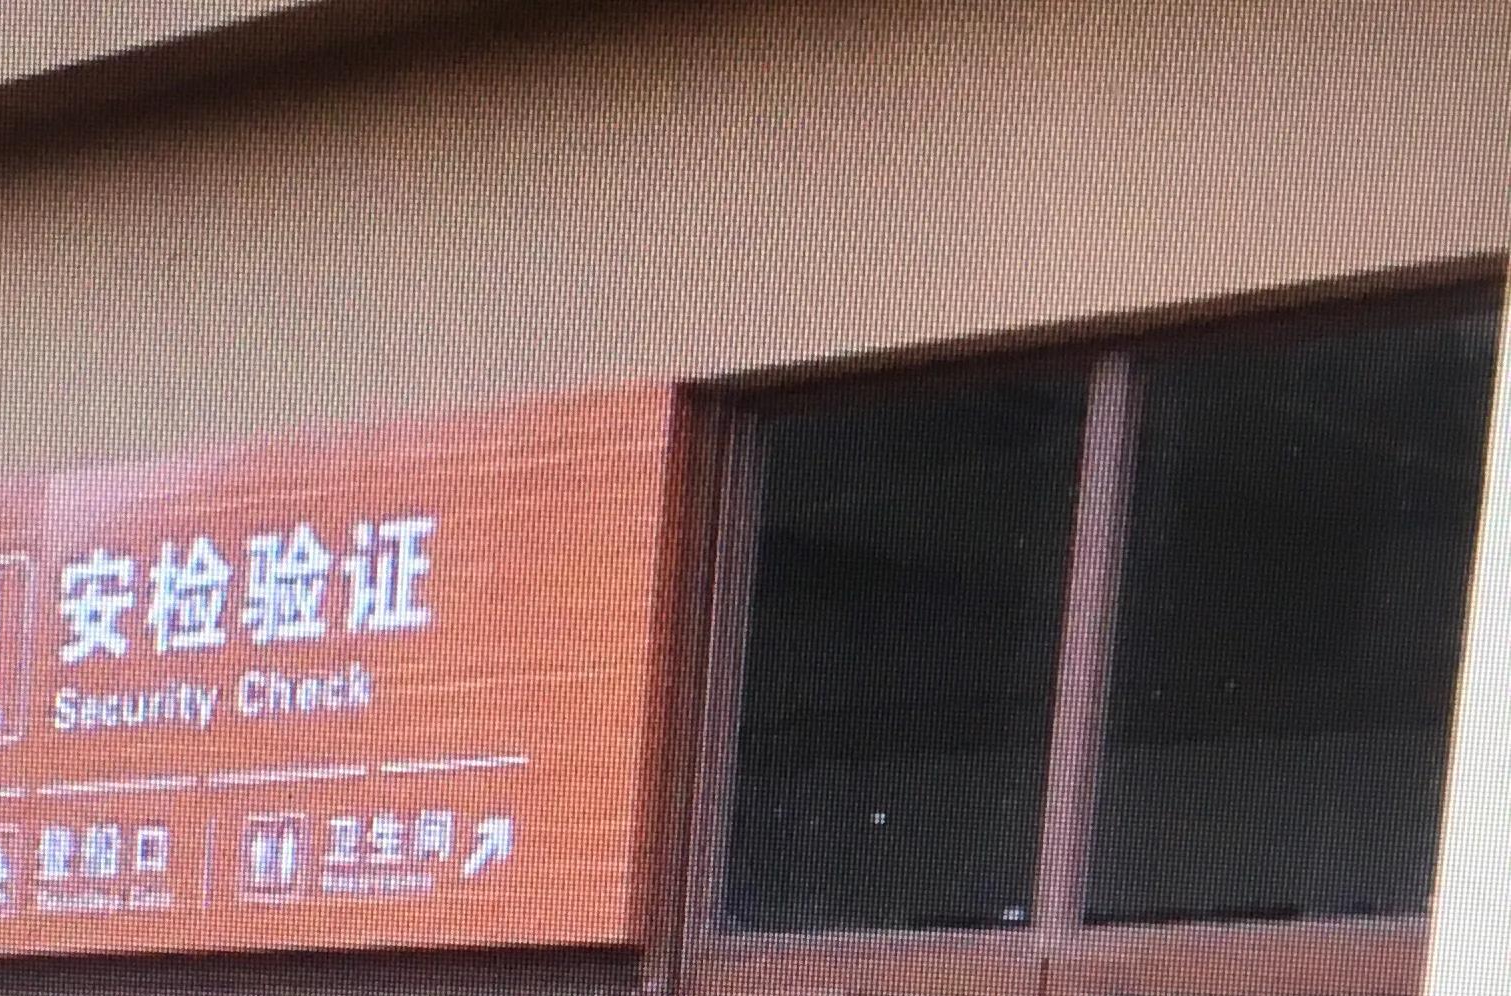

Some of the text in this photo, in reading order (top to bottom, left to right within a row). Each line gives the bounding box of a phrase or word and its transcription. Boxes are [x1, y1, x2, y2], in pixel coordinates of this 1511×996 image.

[58, 516, 436, 664] 安检验证
[53, 660, 373, 731] Security Check
[322, 808, 456, 866] 卫生间
